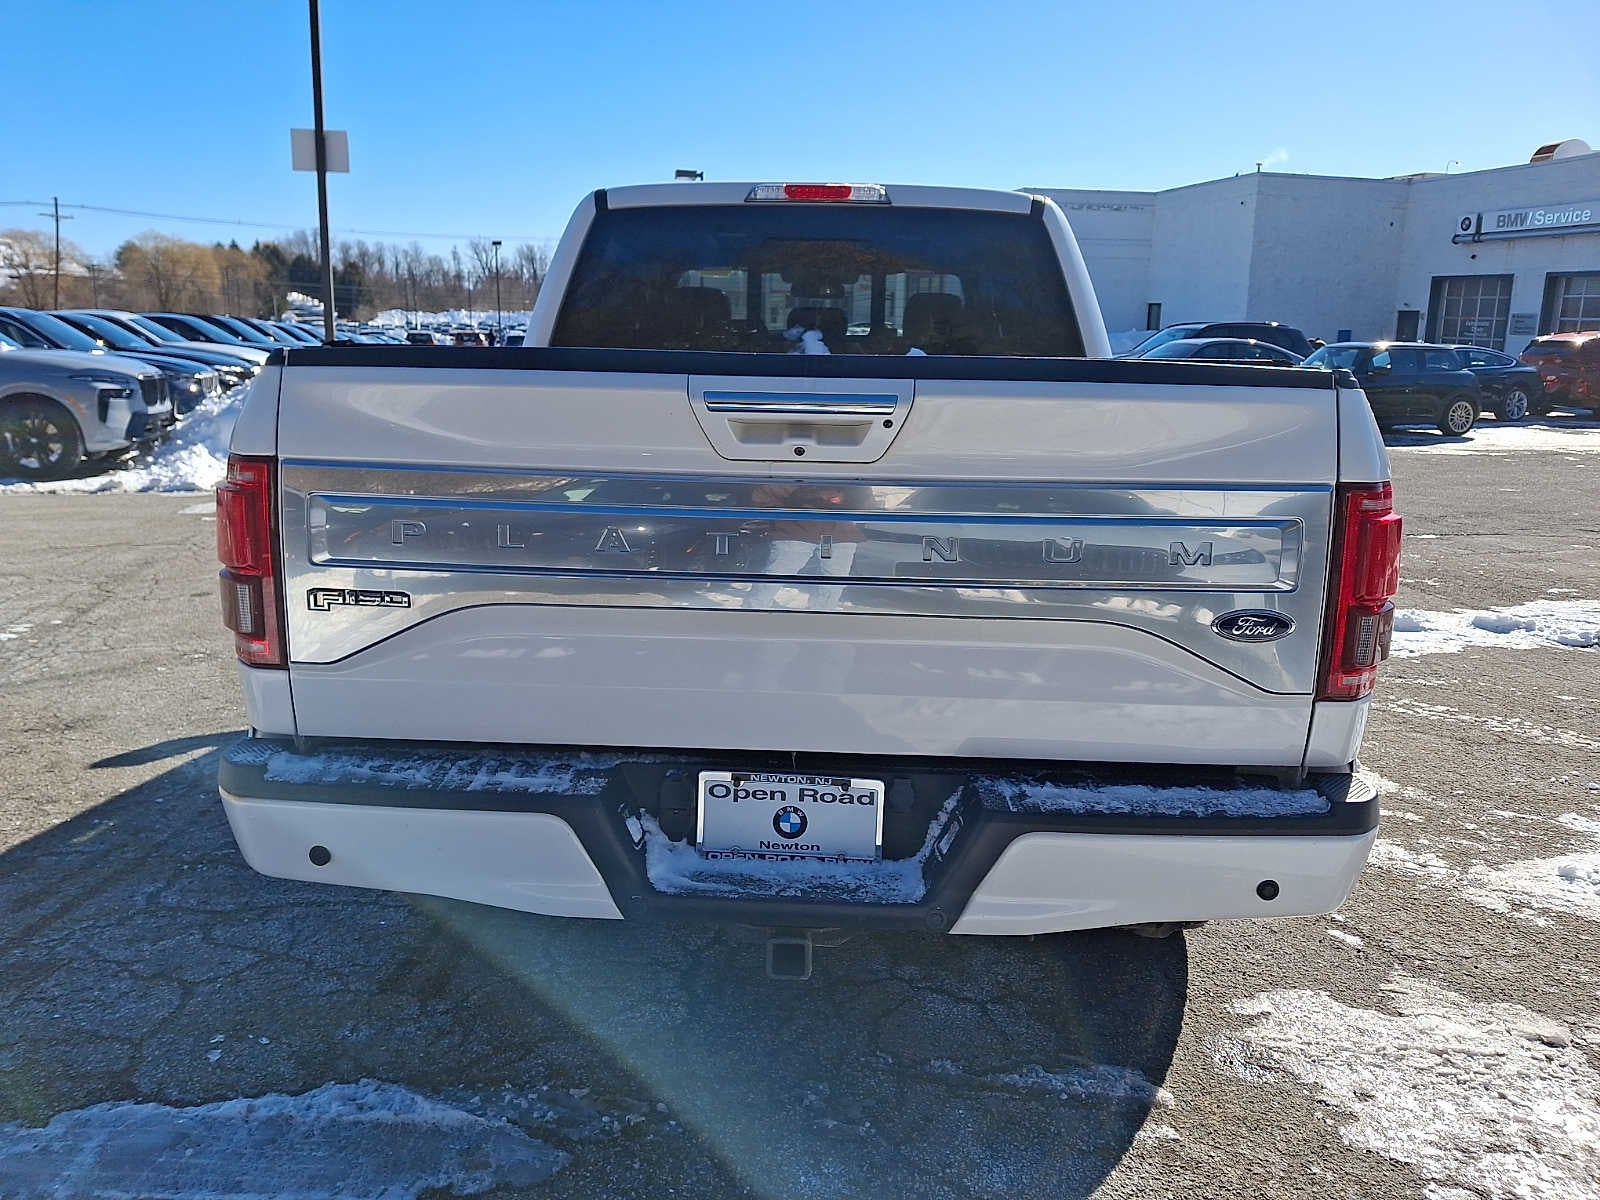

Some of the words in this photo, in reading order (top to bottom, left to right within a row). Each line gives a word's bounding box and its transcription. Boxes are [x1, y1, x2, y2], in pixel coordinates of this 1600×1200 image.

[1535, 208, 1592, 225] Service
[391, 519, 1214, 567] PLATINUM
[1232, 616, 1278, 636] Ford
[815, 777, 832, 785] NJ
[708, 783, 786, 802] Open
[799, 788, 875, 806] Road
[777, 806, 805, 817] BMW
[759, 840, 820, 852] Newton
